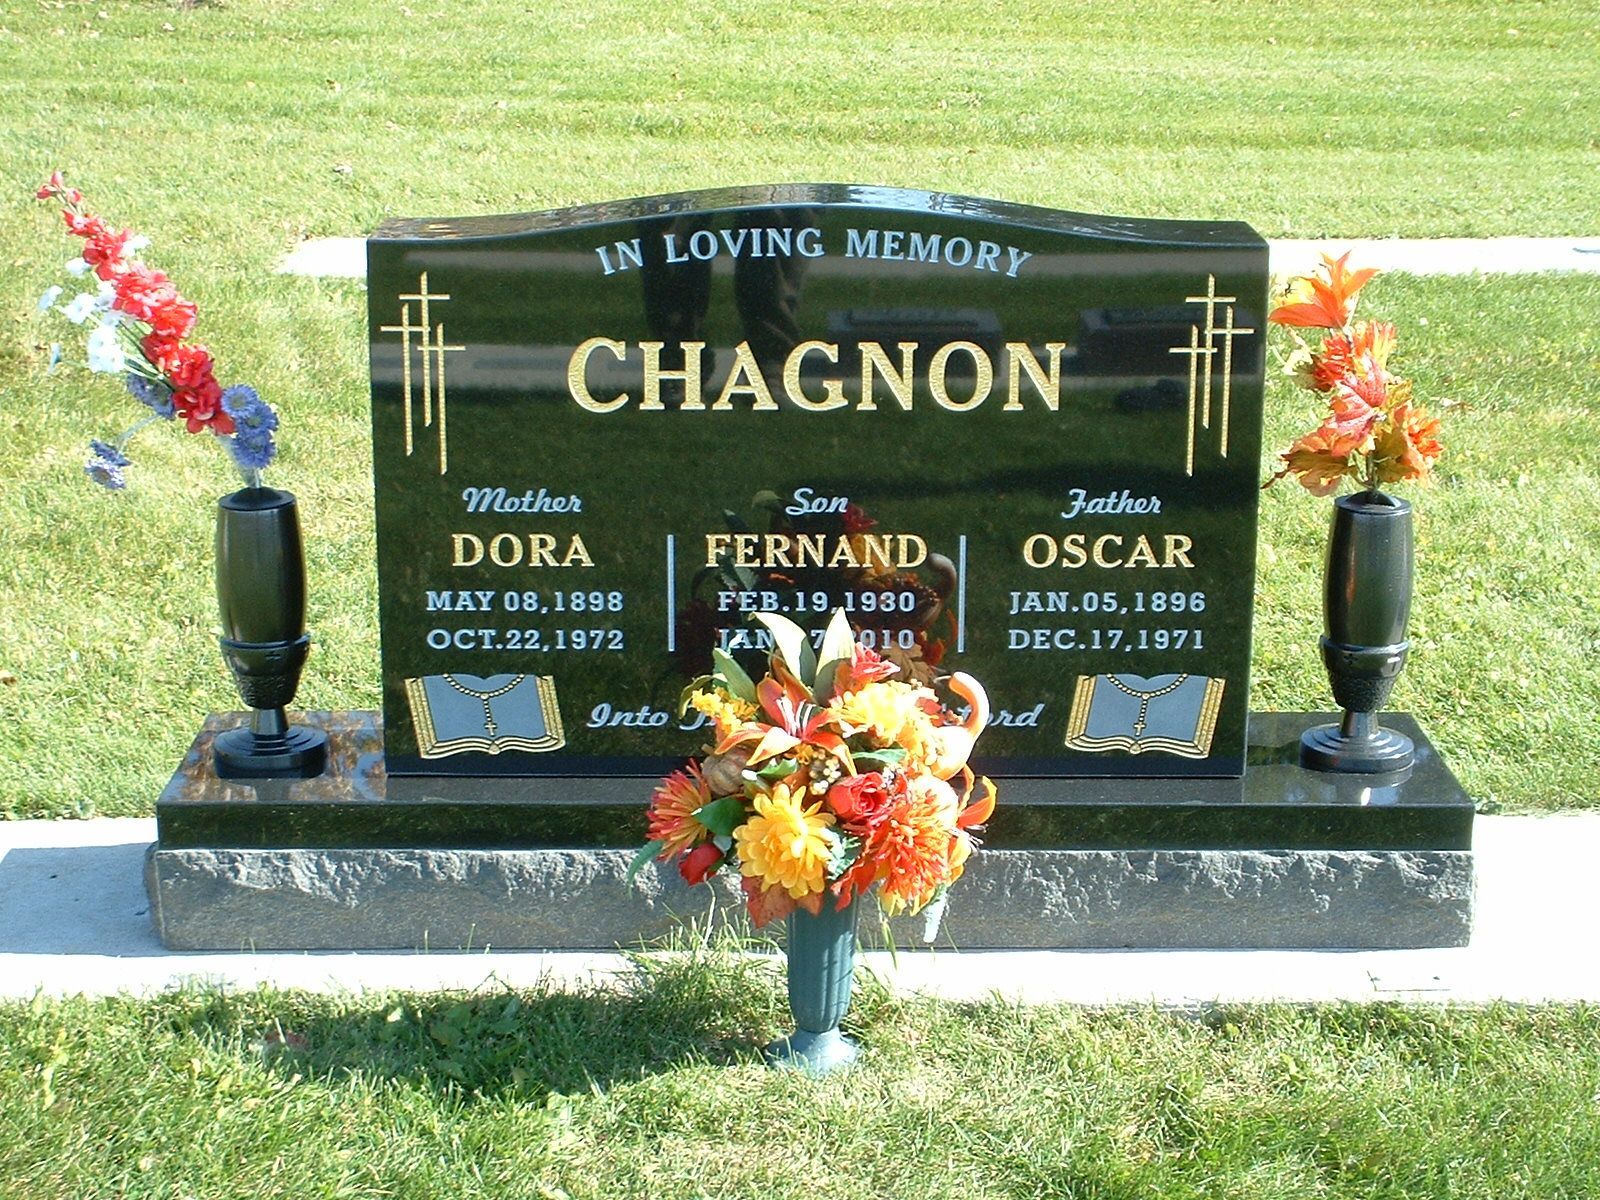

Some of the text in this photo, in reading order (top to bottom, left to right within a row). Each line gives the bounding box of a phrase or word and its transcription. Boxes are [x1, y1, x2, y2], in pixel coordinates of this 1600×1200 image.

[595, 227, 1033, 278] IN LOVING MEMORY
[567, 337, 1065, 413] CHAGNON
[462, 487, 582, 514] Mother
[786, 488, 849, 515] Son
[1062, 488, 1162, 518] Father
[452, 533, 595, 567] DORA
[705, 533, 928, 568] FERNAND
[1022, 534, 1195, 568] OSCAR
[425, 591, 624, 614] MAY 08,1898
[718, 591, 915, 613] FEB.19,1930
[1010, 591, 1206, 614] JAN.05,1896
[427, 628, 624, 651] OCT.22,1972
[1008, 629, 1204, 651] DEC.17,1971
[586, 702, 669, 728] Into
